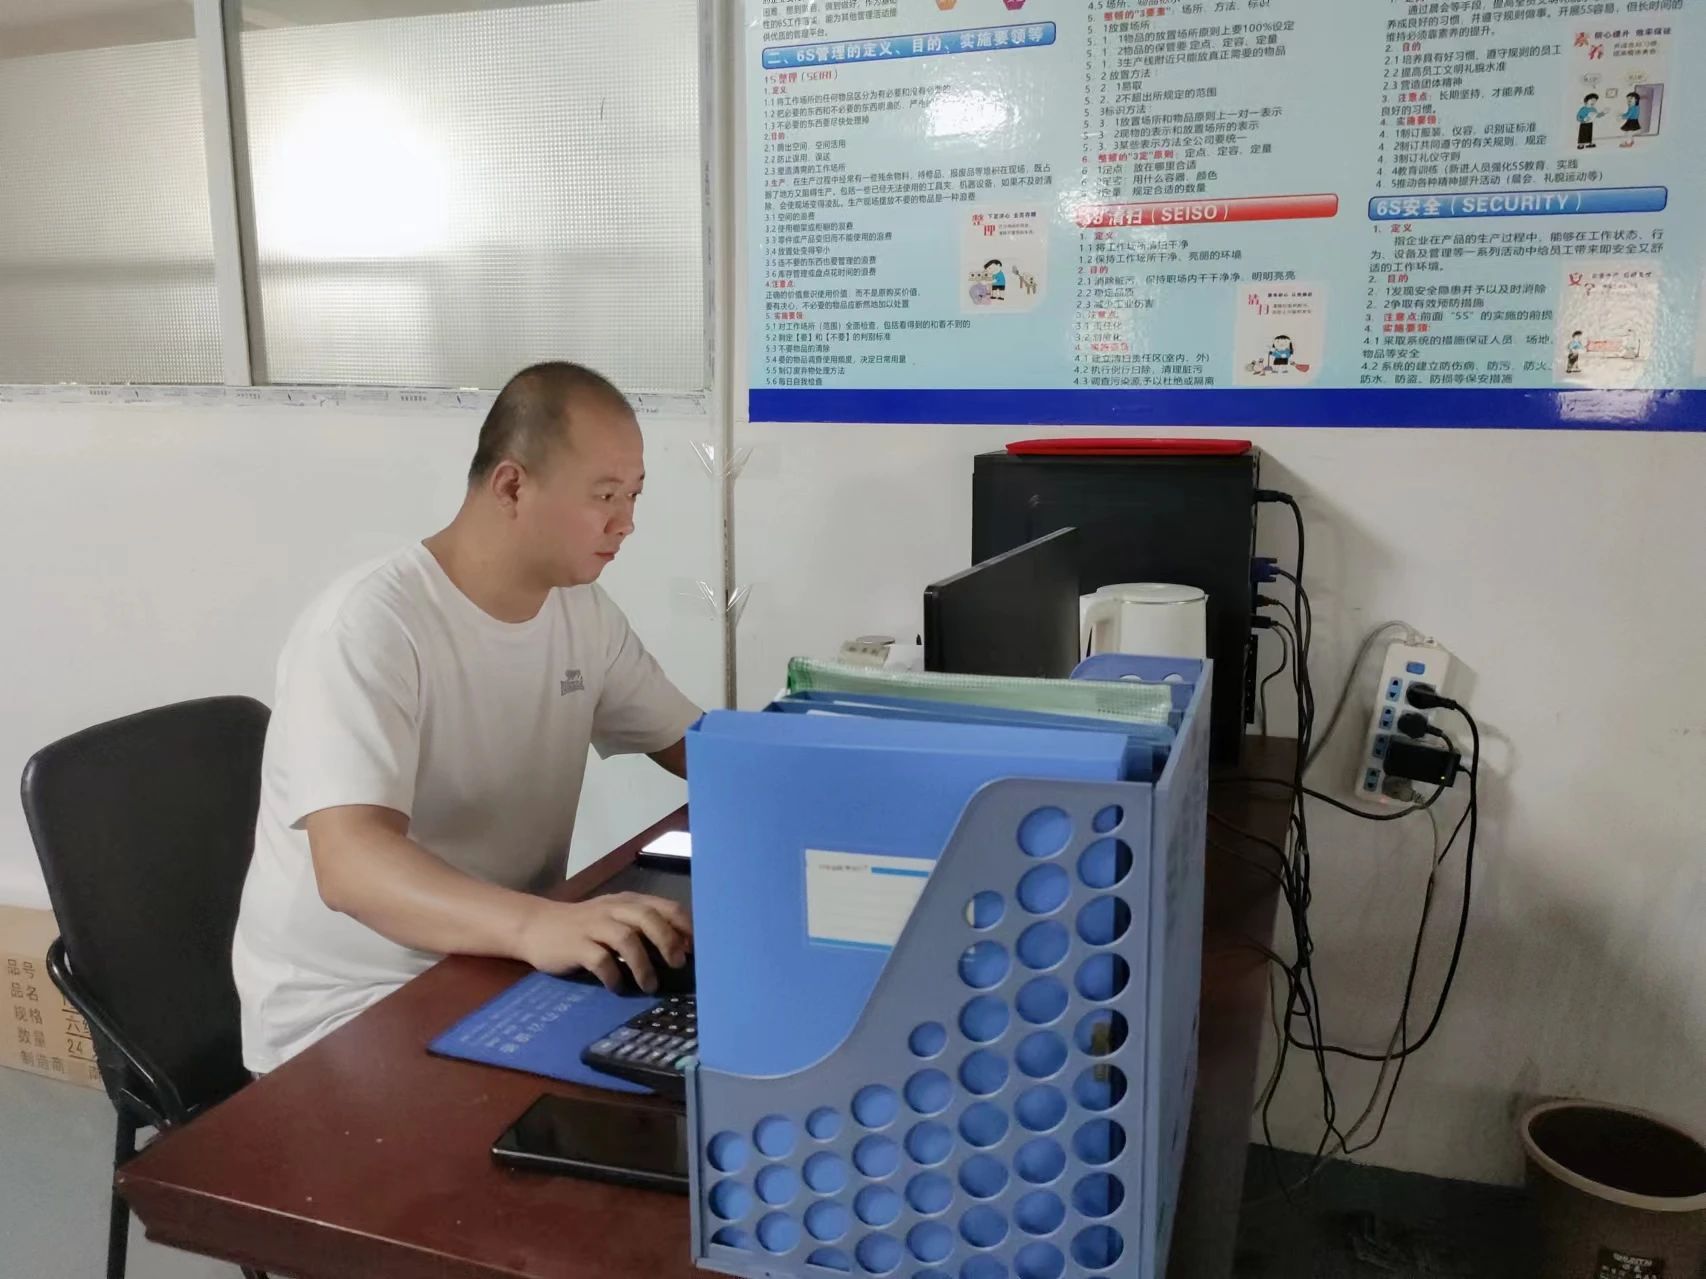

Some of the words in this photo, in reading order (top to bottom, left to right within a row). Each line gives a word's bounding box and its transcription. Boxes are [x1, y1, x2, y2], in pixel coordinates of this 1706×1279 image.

[7, 958, 36, 979] 品号
[10, 982, 39, 1001] 品名
[67, 1038, 83, 1054] 24
